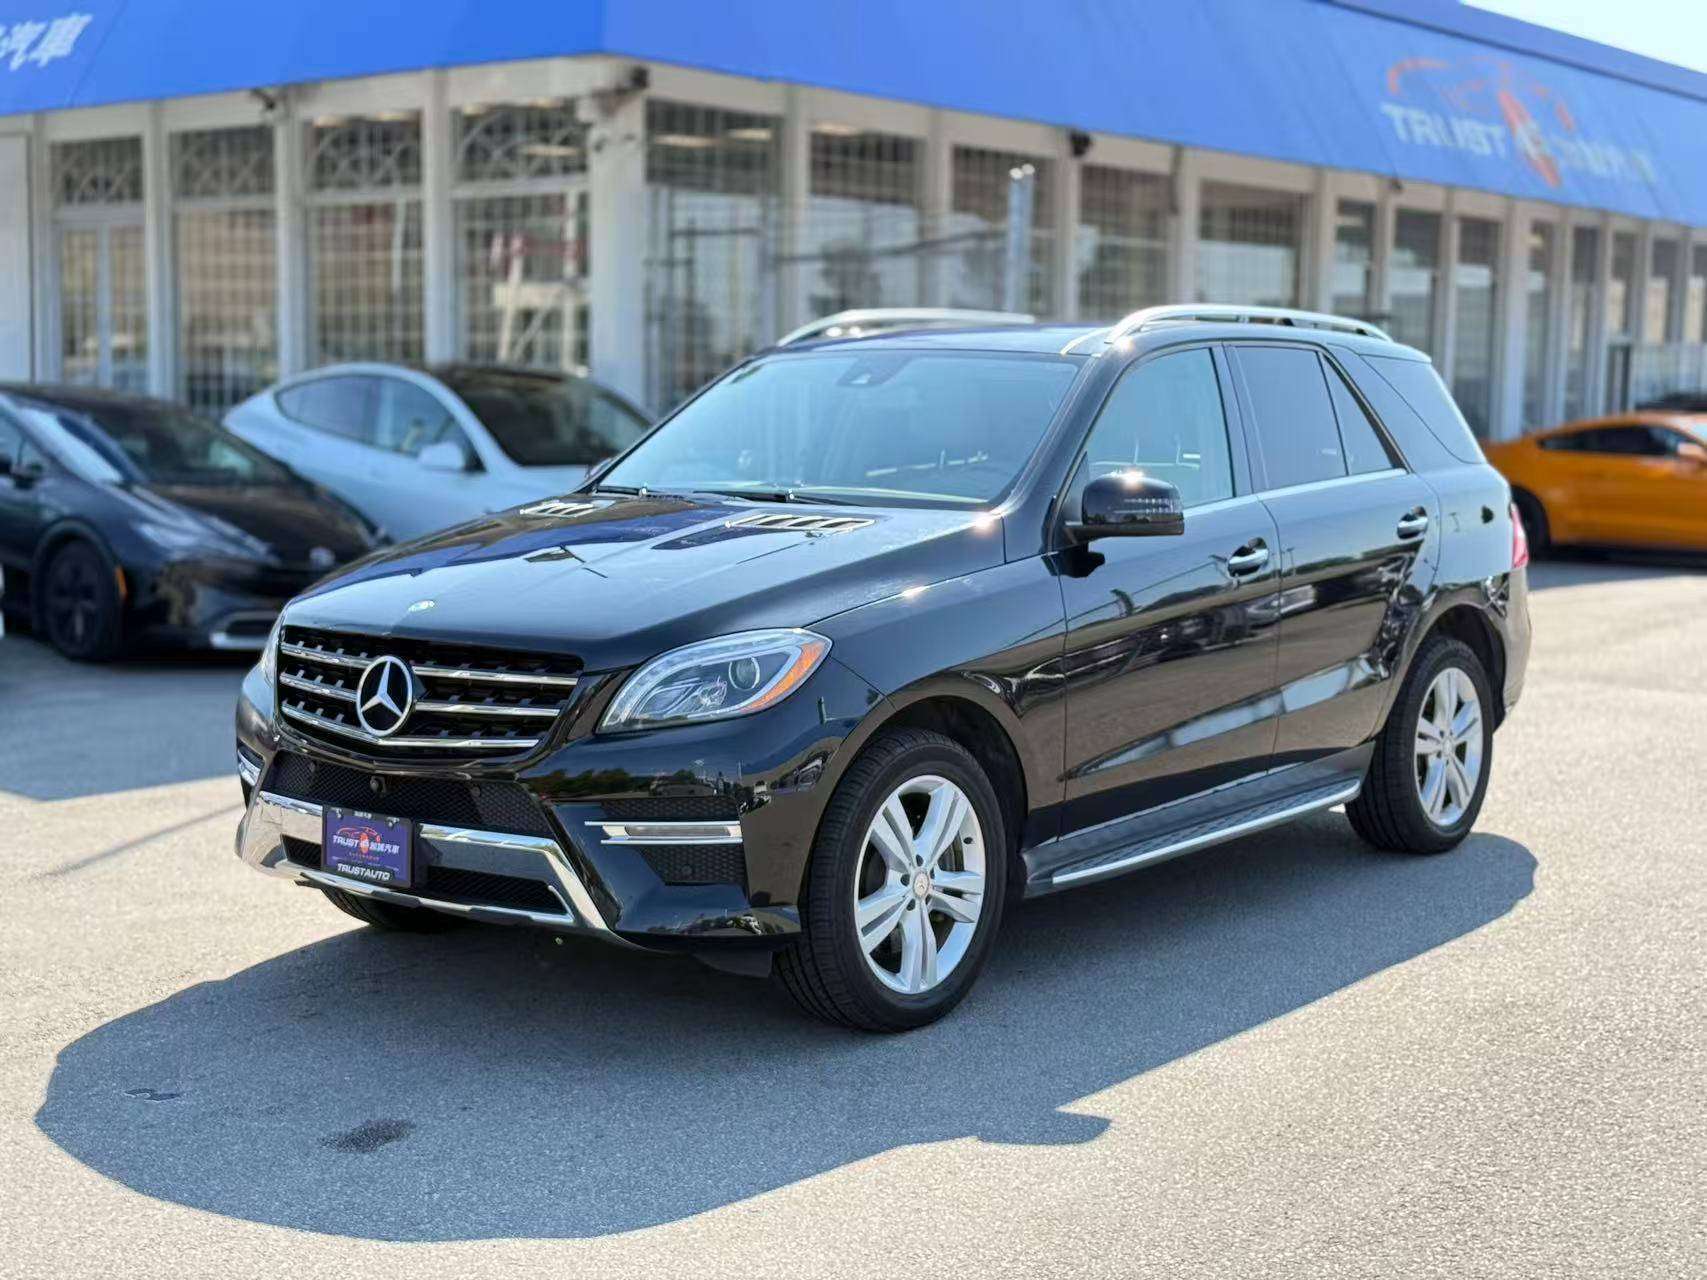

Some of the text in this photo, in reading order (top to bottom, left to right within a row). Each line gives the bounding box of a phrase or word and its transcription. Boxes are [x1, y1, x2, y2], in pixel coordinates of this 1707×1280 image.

[1380, 102, 1507, 158] TRUST
[333, 835, 359, 848] TRUST
[337, 863, 391, 880] TRUSTAUTO
